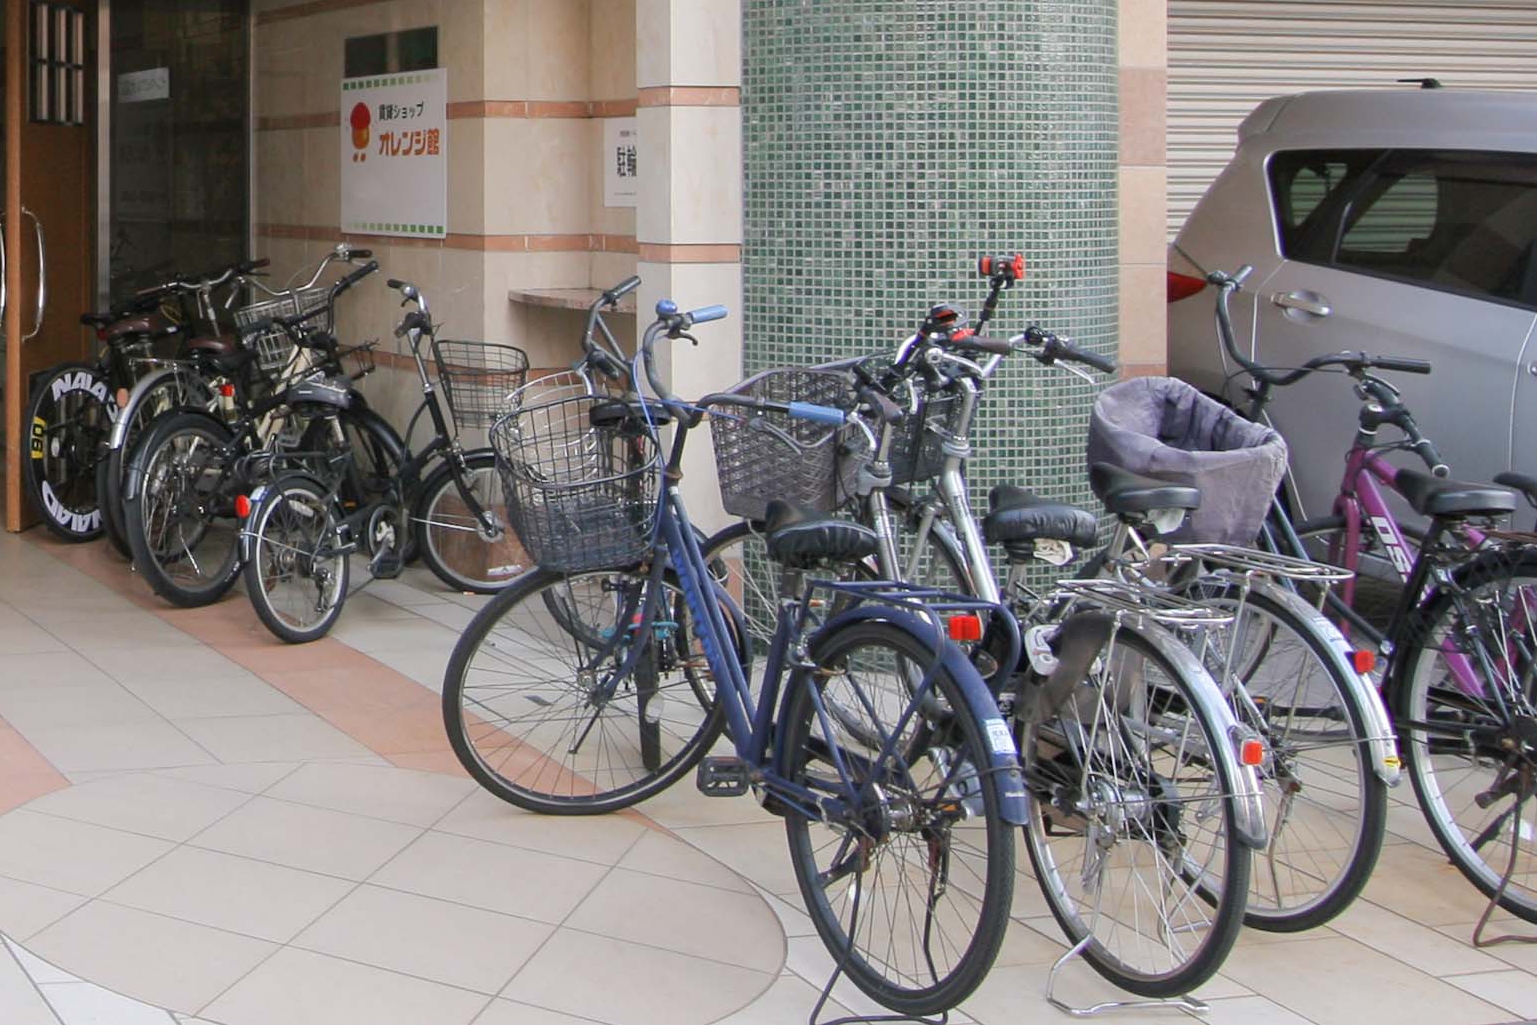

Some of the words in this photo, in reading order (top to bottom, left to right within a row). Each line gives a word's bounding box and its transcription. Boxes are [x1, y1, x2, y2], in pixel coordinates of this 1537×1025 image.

[379, 127, 440, 156] オレンジ館
